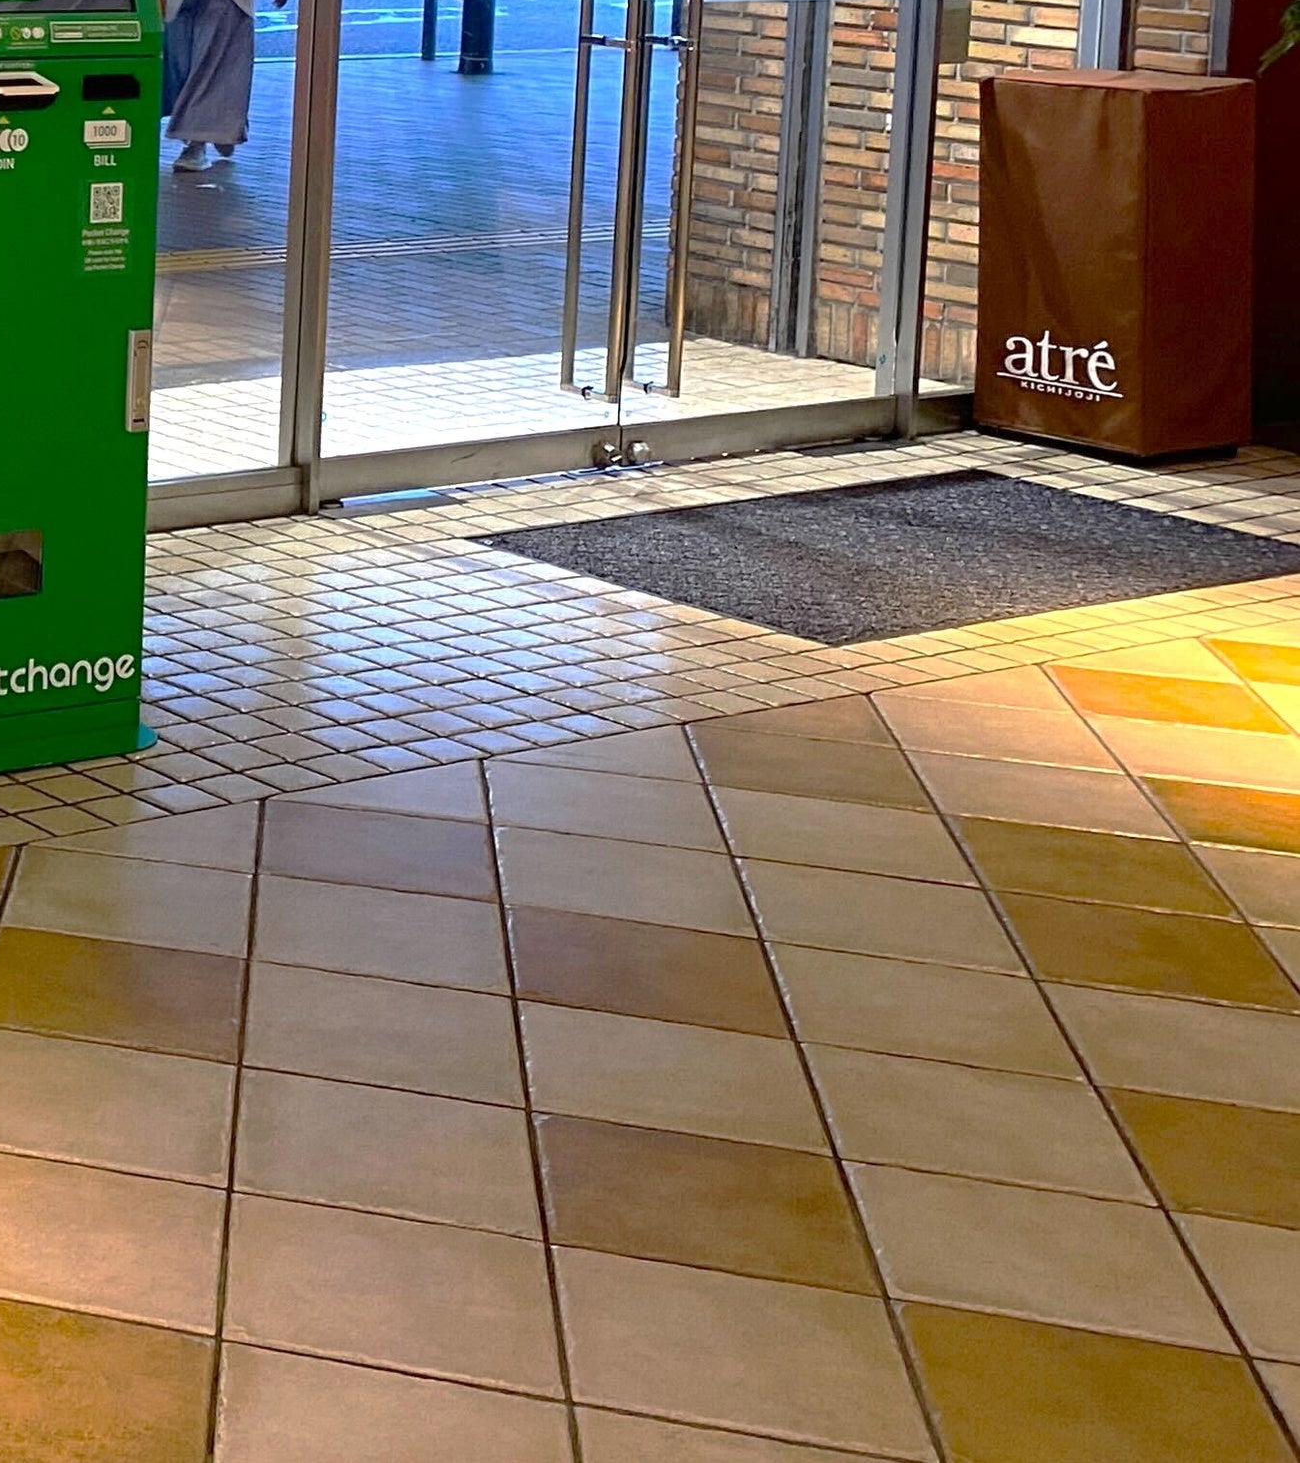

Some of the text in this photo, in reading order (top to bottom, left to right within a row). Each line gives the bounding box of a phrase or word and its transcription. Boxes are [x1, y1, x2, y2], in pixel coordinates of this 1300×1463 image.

[92, 125, 117, 137] 1000
[12, 134, 26, 147] 10
[93, 154, 117, 167] BILL
[1004, 329, 1119, 392] atré
[1020, 380, 1101, 403] KICHIJOJI
